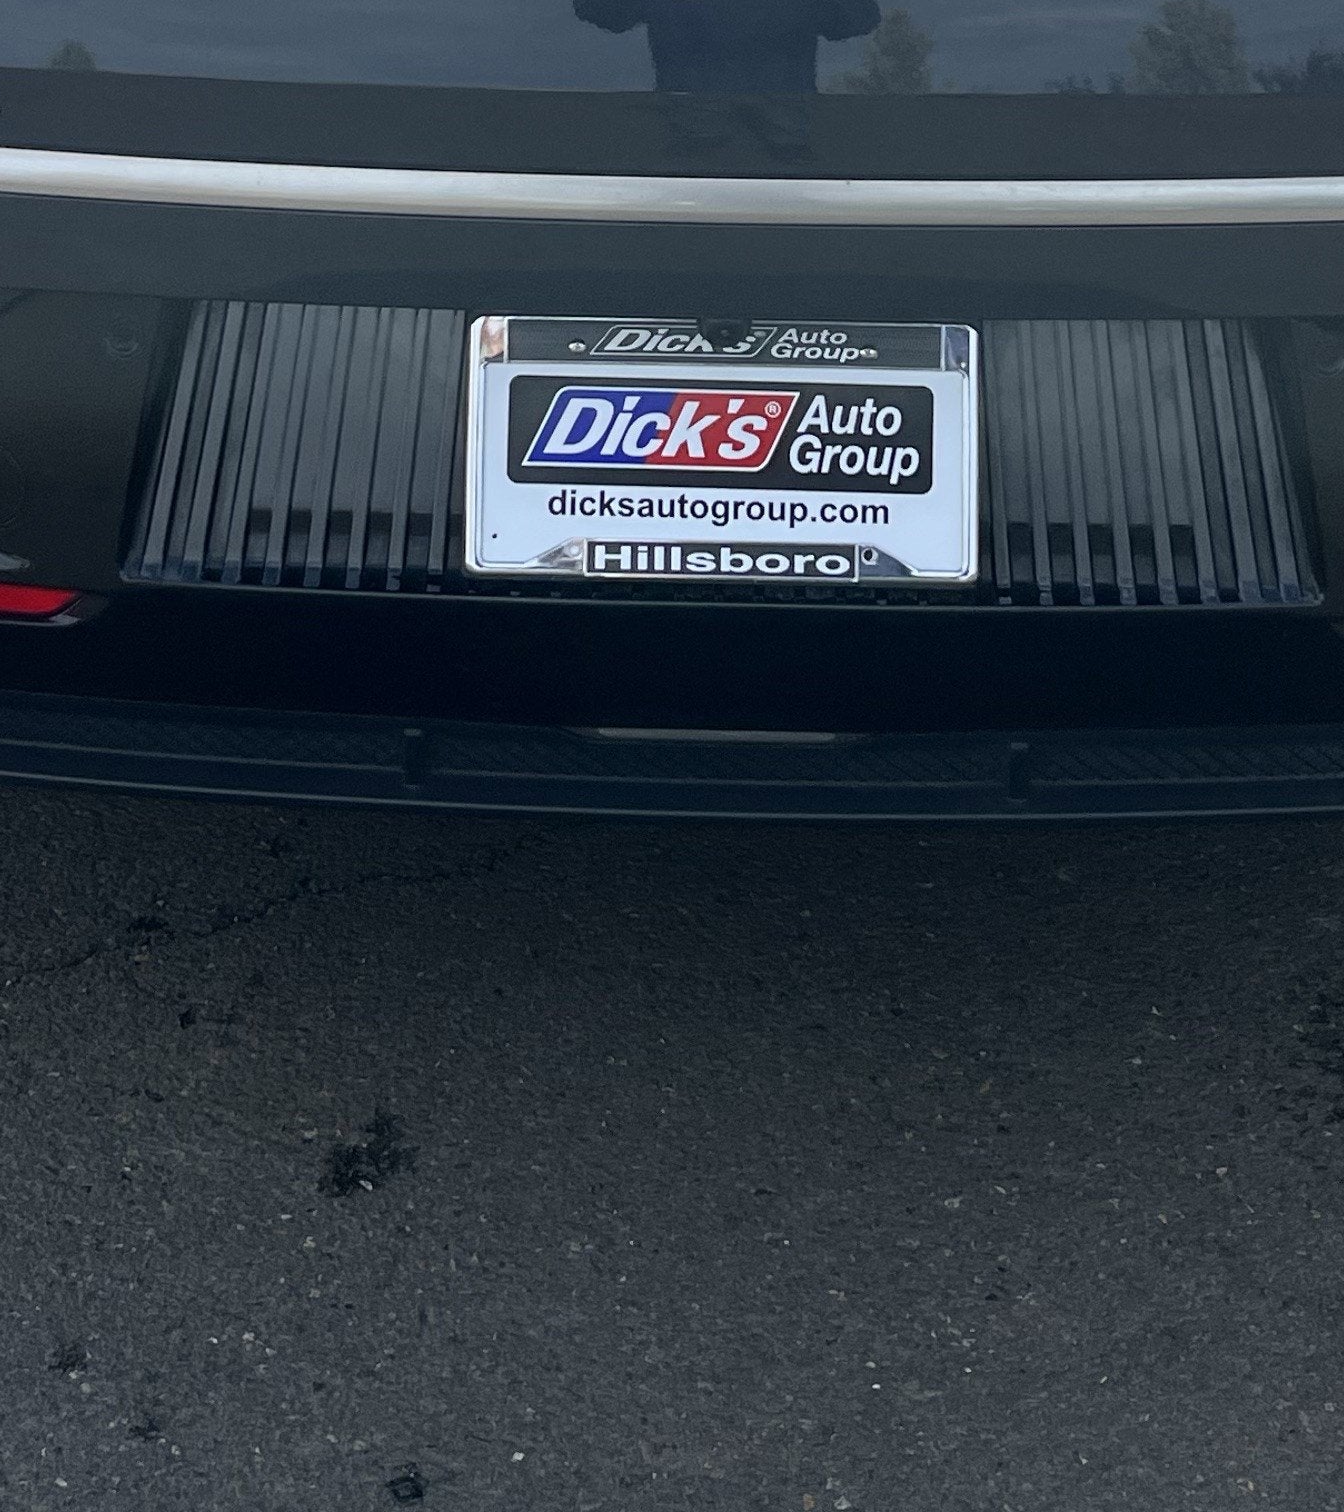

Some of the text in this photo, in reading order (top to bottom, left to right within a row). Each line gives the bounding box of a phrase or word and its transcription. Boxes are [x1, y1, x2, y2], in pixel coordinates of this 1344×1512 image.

[770, 343, 860, 363] Group
[777, 328, 848, 344] Auto
[543, 394, 902, 460] Dick's Auto
[789, 433, 920, 485] Group
[547, 489, 889, 528] dicksautogroup.com
[593, 544, 851, 574] Hillsboro
